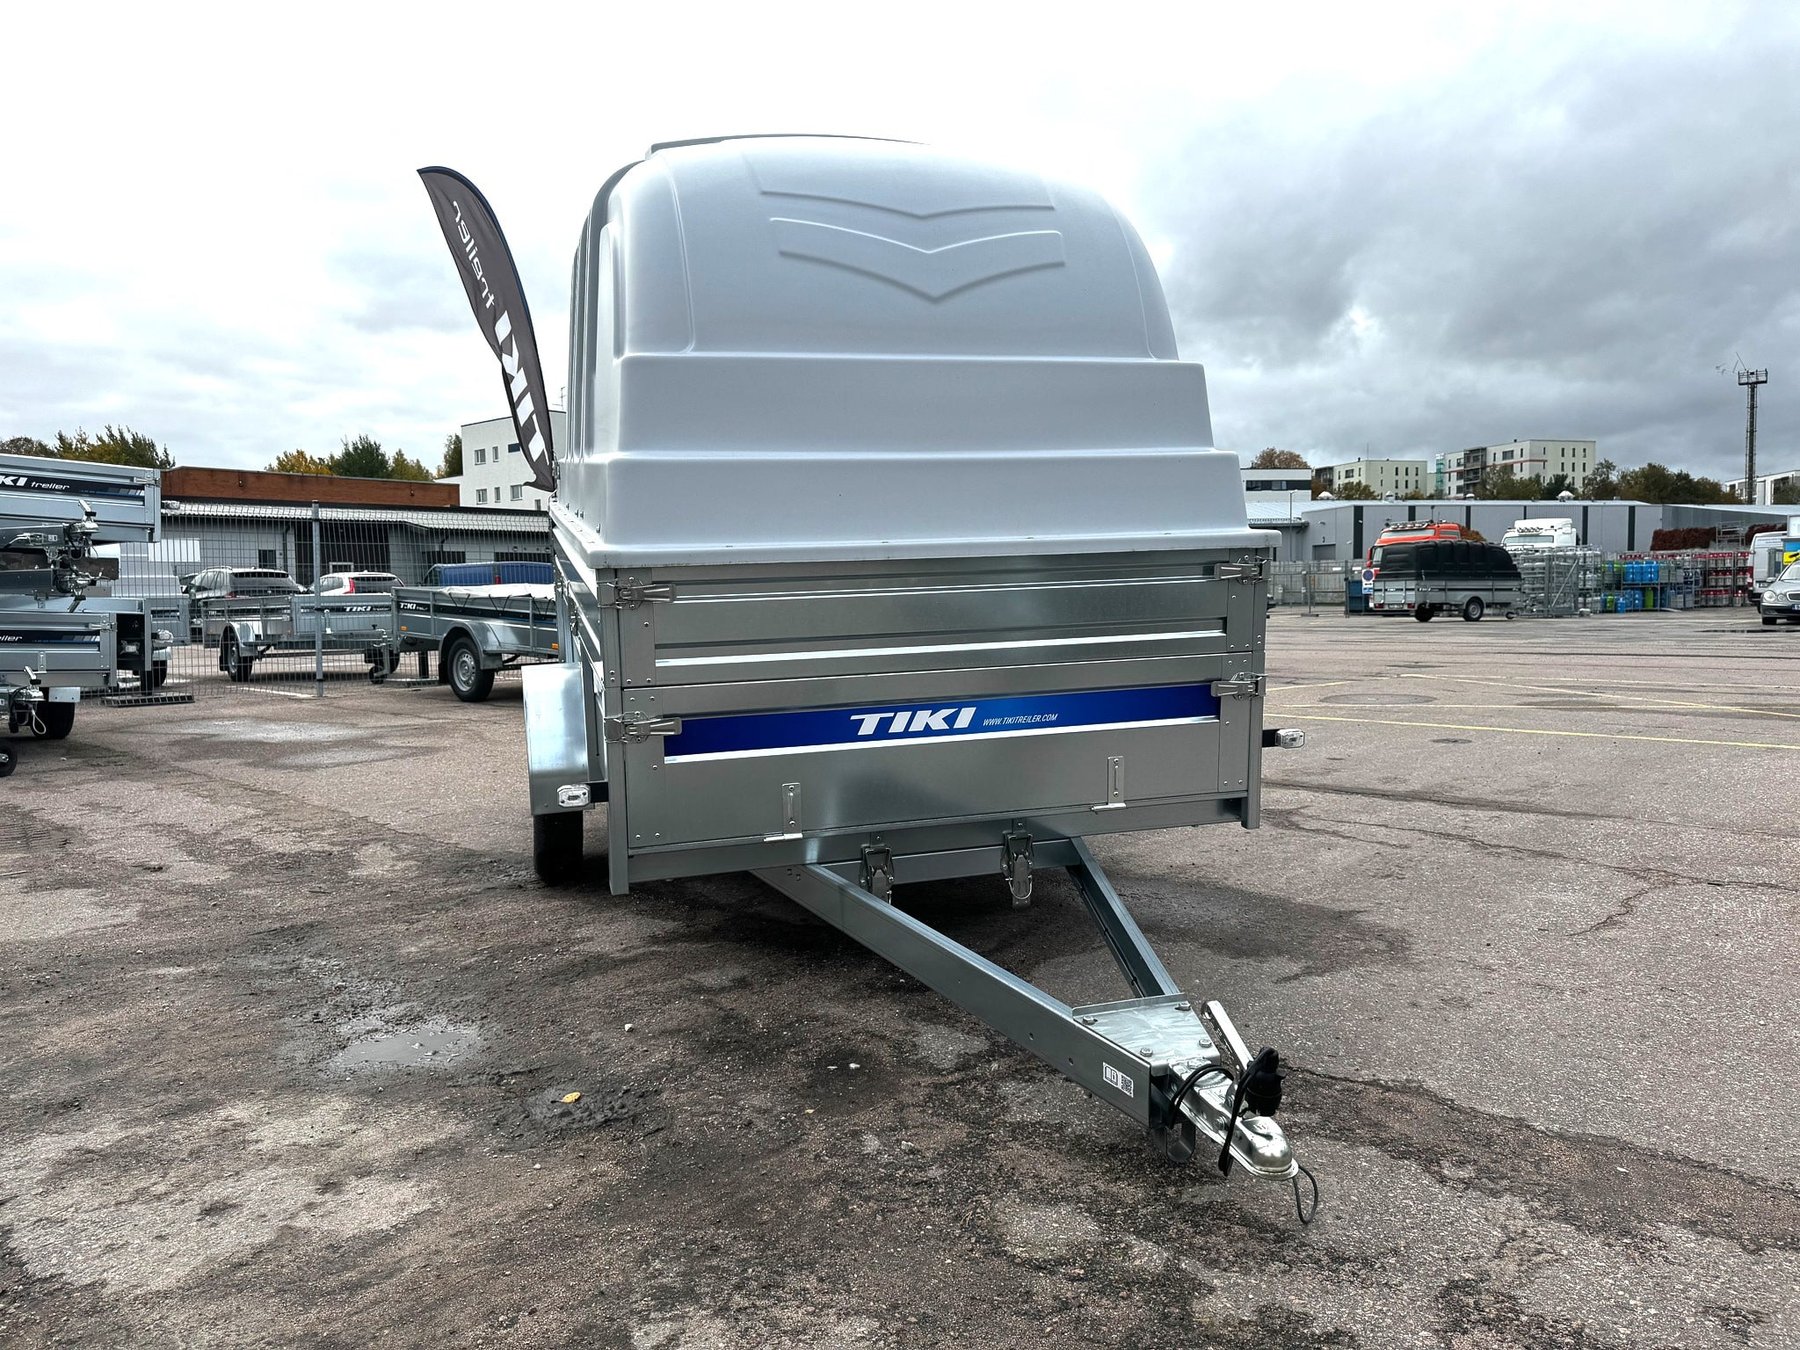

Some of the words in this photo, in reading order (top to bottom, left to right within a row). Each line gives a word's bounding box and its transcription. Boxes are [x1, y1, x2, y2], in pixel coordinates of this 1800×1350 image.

[30, 481, 70, 490] treiler
[850, 706, 977, 736] TIKI
[982, 713, 1059, 727] WWW.TIKITREILER.COM
